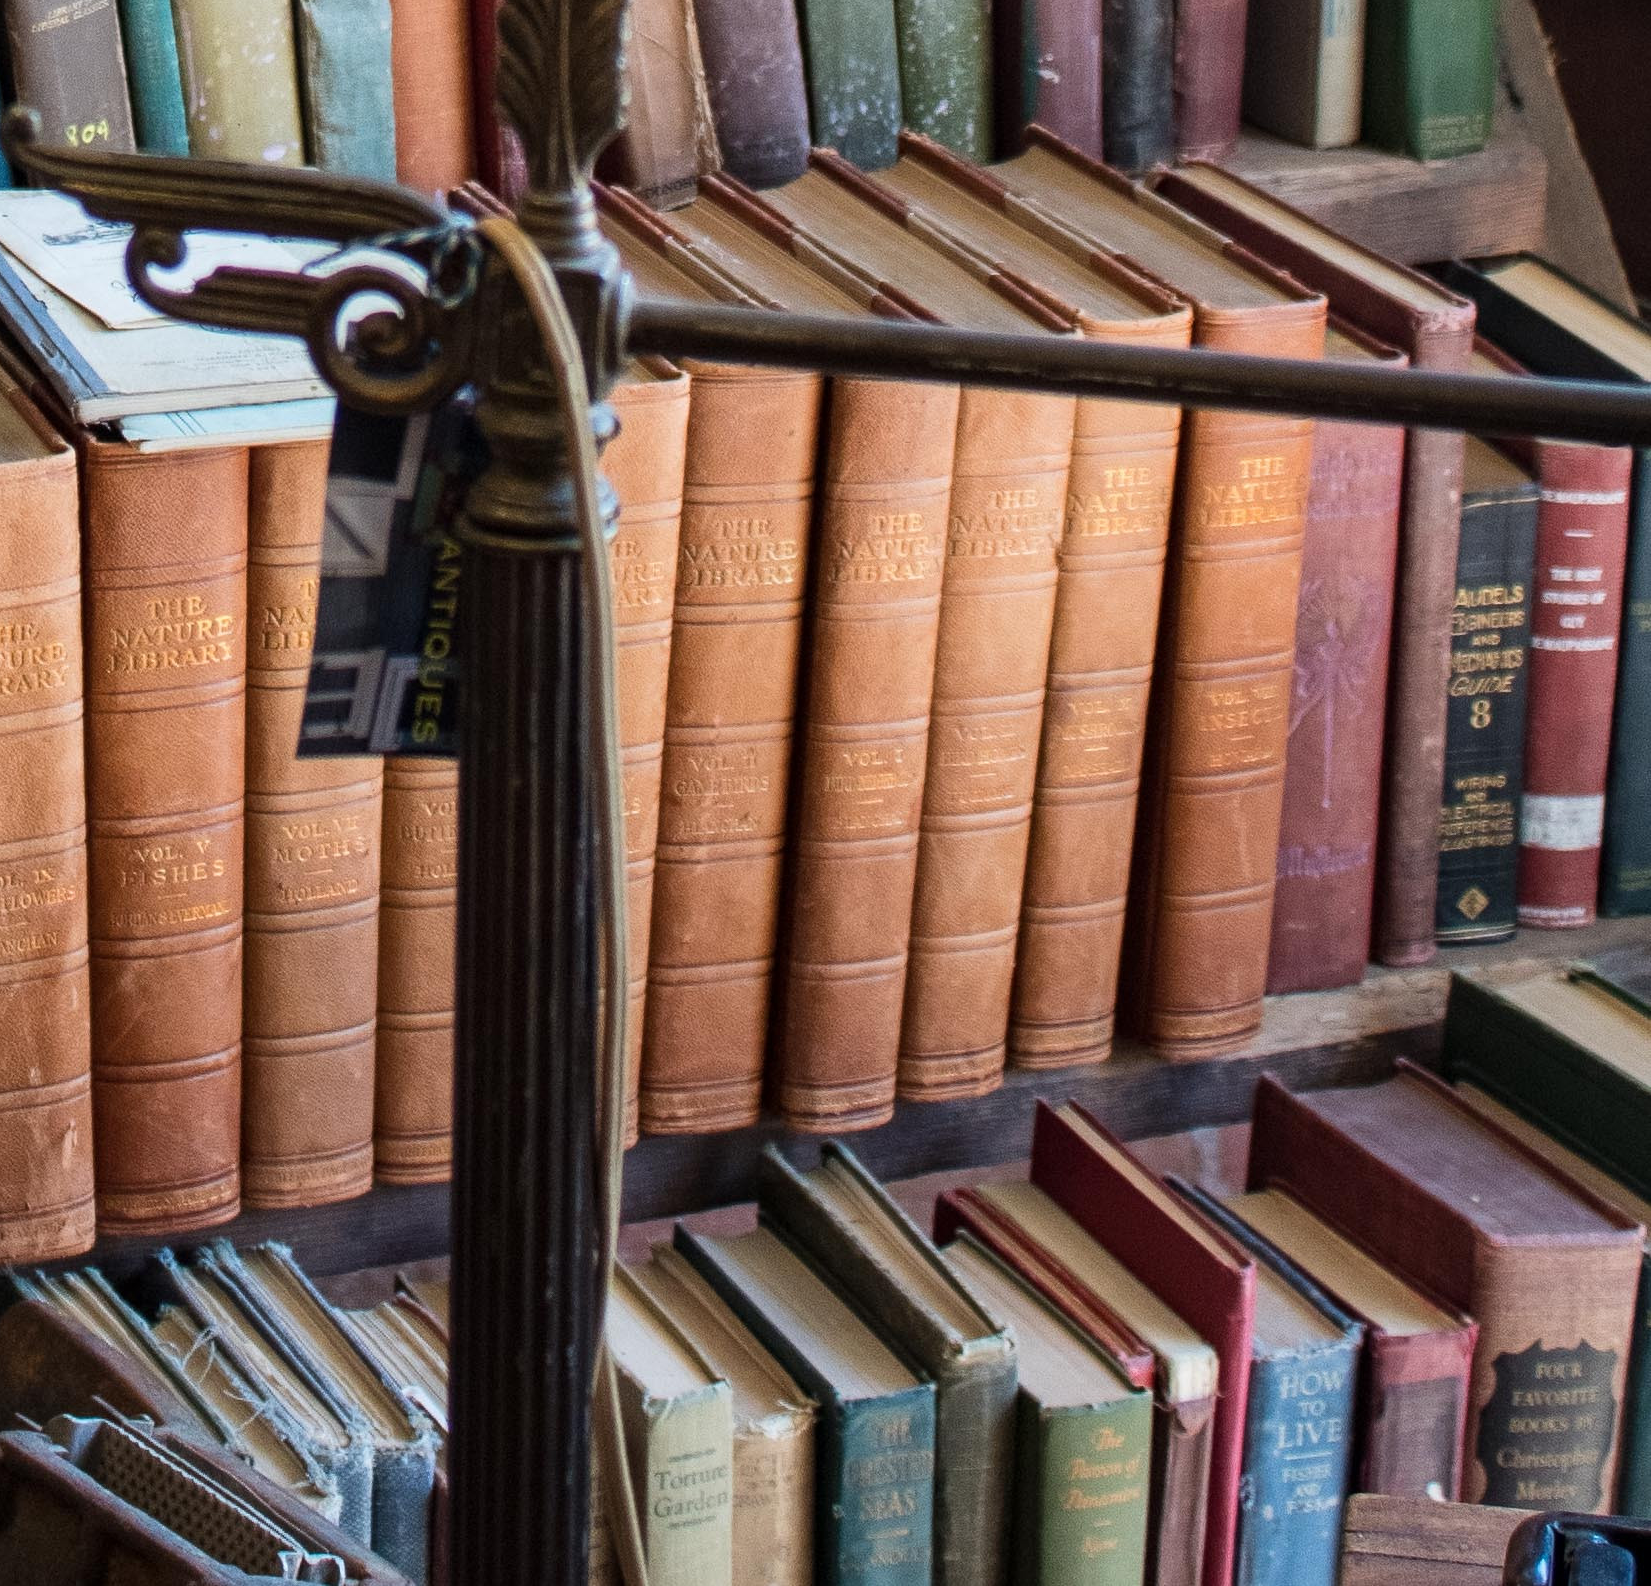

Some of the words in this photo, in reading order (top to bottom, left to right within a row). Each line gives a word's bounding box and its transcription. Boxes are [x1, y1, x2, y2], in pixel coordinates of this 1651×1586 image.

[111, 615, 233, 649] NATURE
[412, 538, 461, 743] ANTIQUES
[106, 640, 233, 674] LIBRARY
[1470, 700, 1491, 728] 8
[273, 836, 368, 863] MOTHS
[122, 859, 224, 887] FISHES
[1280, 1371, 1341, 1399] HOW
[1298, 1401, 1325, 1417] TO
[1278, 1419, 1342, 1449] LIVE
[654, 1466, 728, 1490] Torture
[654, 1491, 728, 1517] Garden
